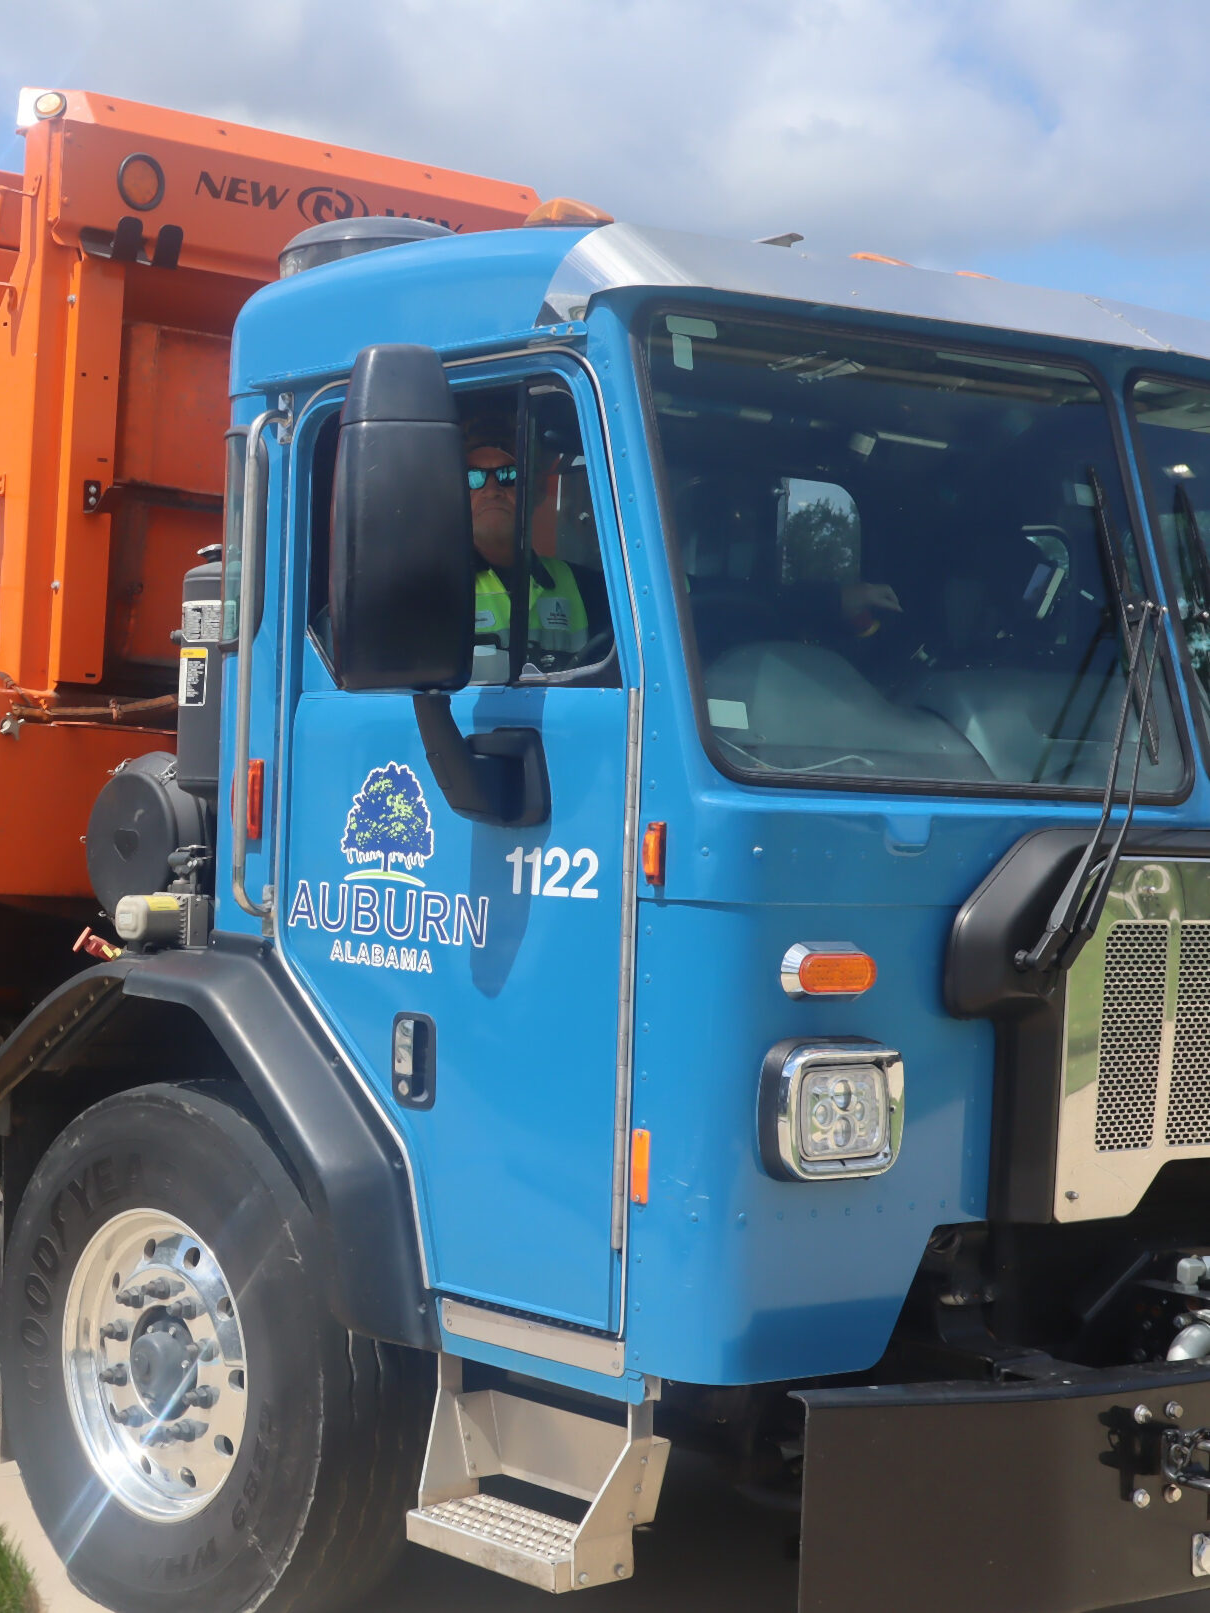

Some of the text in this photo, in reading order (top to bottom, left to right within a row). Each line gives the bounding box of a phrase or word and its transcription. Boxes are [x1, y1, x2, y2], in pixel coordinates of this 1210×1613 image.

[195, 171, 290, 210] NEW
[505, 846, 599, 899] 1122
[287, 880, 490, 948] AUBURN
[329, 939, 433, 974] ALABAMA
